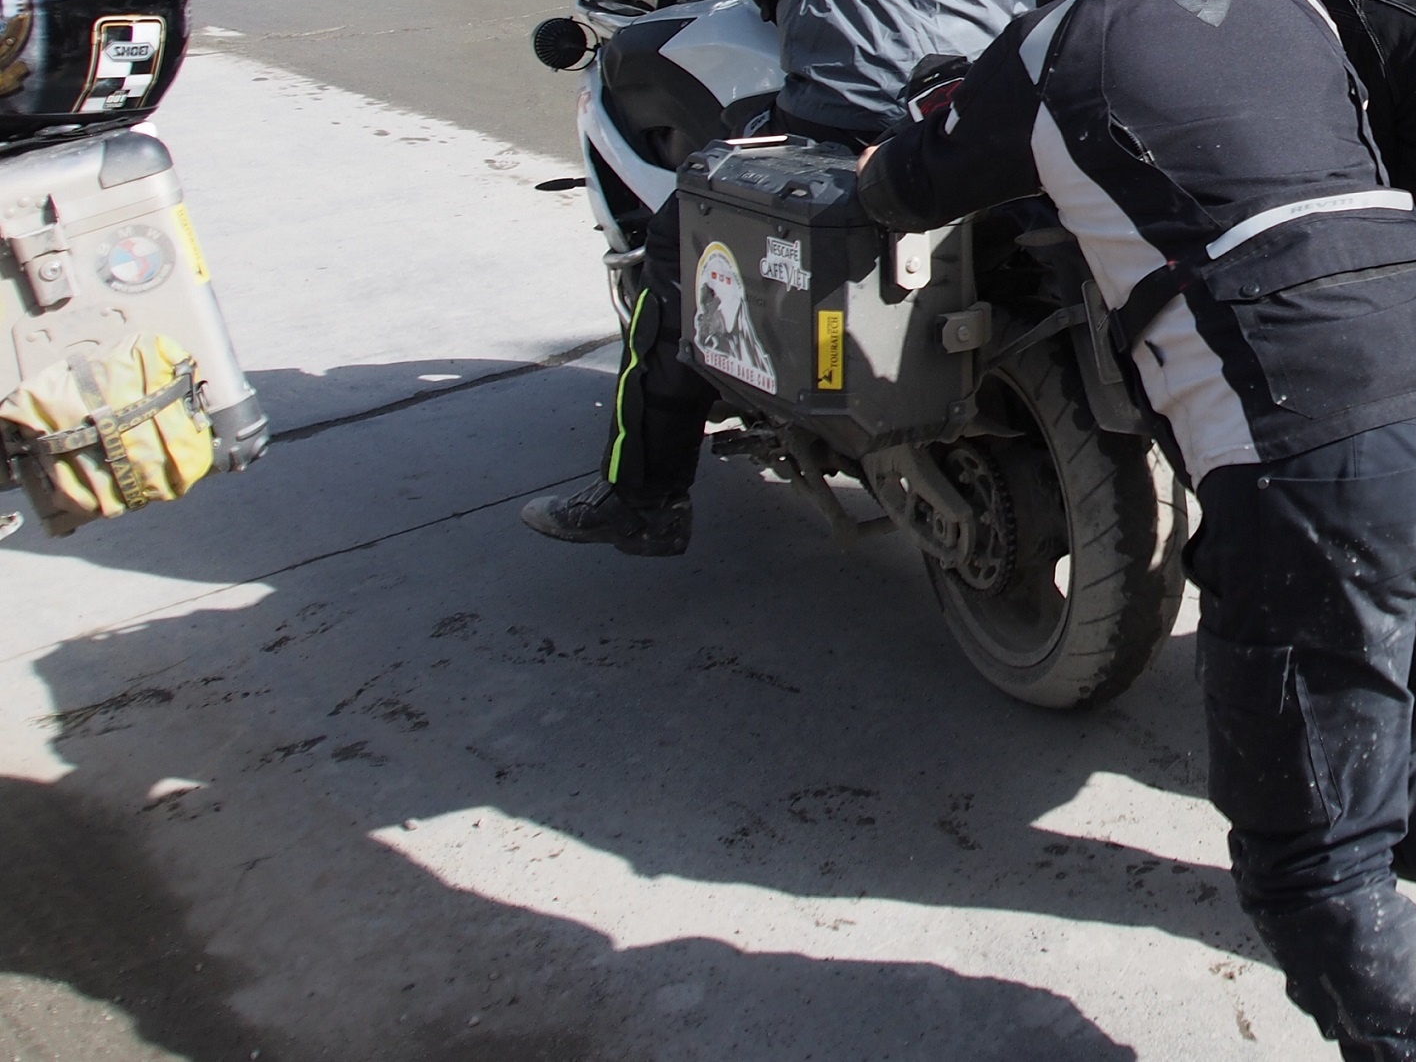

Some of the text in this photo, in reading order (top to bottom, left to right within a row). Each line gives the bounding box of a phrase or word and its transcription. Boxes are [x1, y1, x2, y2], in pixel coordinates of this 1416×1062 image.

[113, 45, 149, 57] SHOEI
[830, 316, 839, 368] TOURATECH
[706, 350, 734, 374] EVEREST
